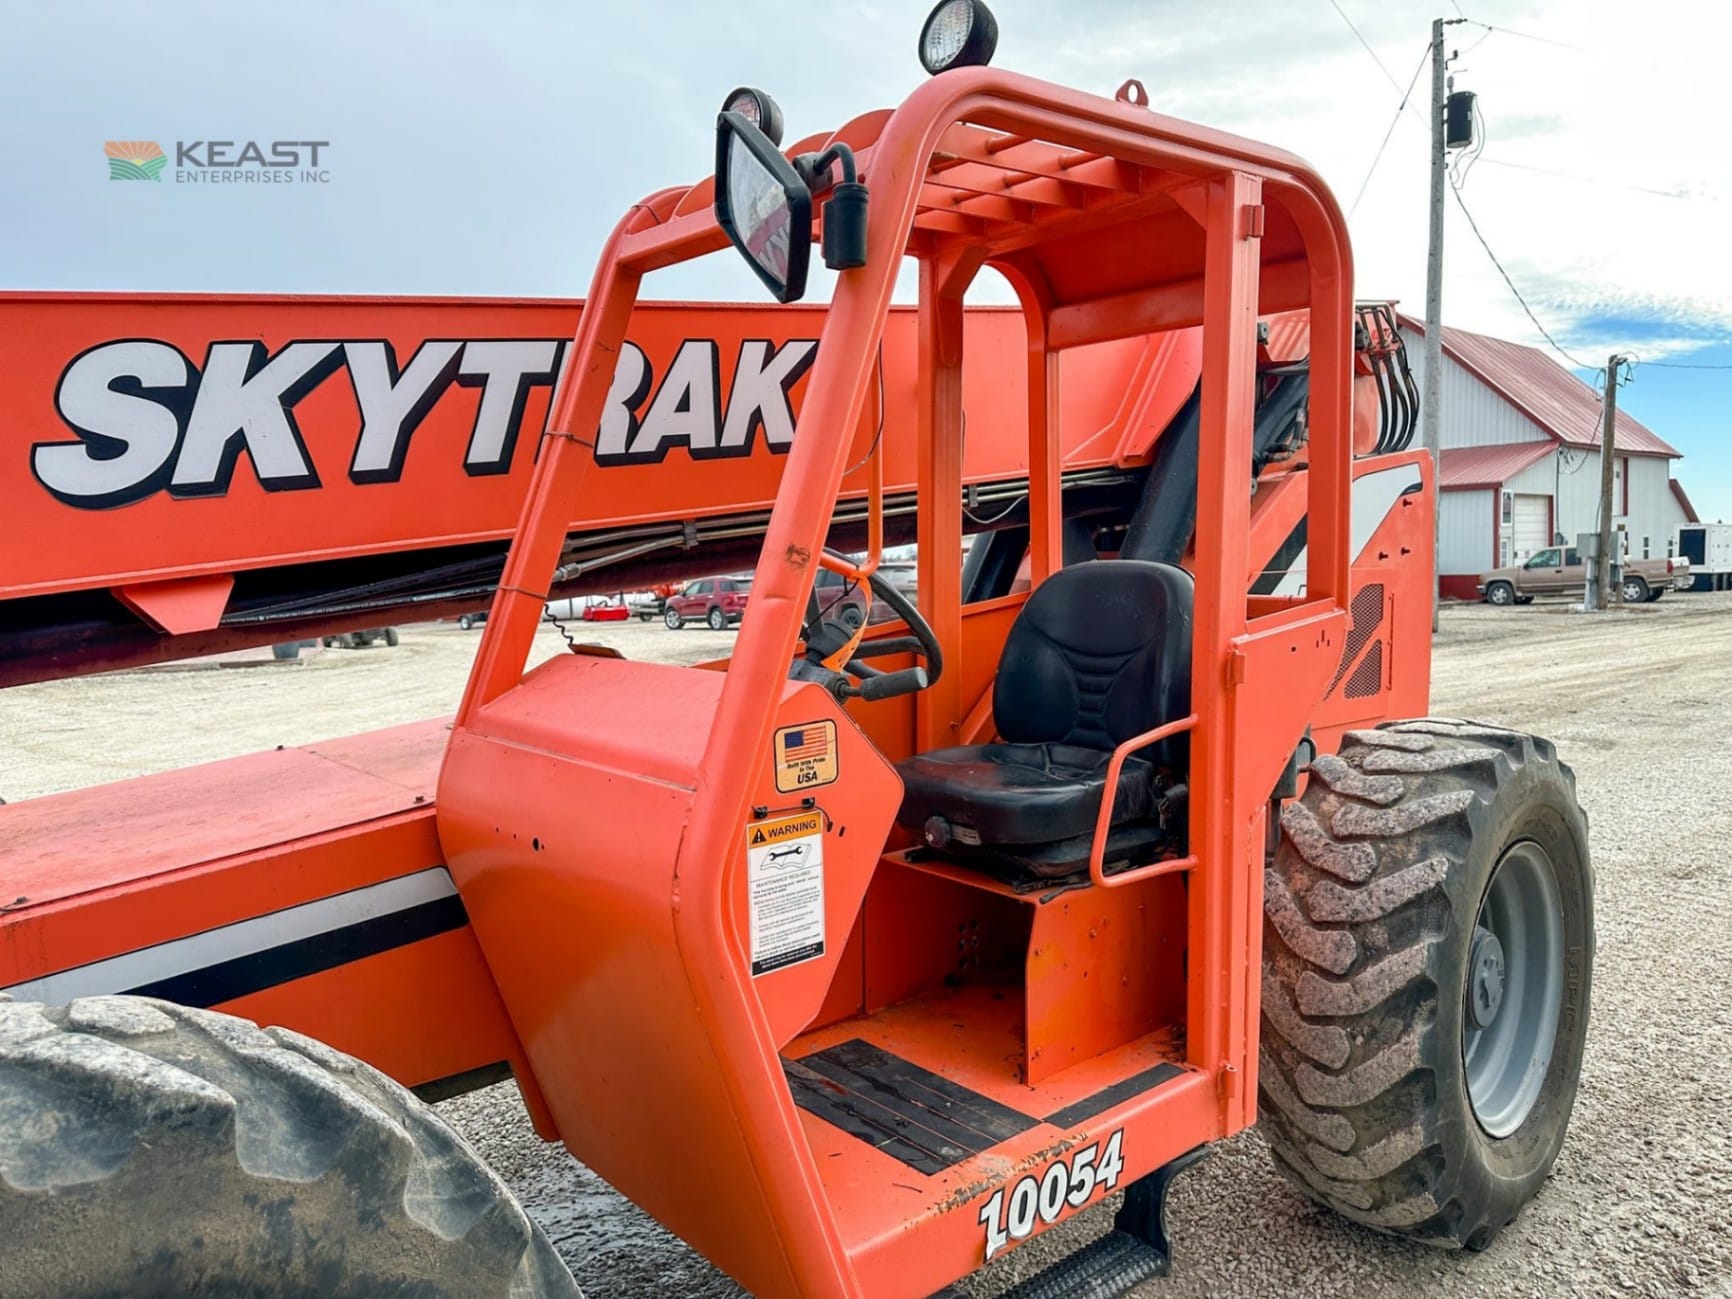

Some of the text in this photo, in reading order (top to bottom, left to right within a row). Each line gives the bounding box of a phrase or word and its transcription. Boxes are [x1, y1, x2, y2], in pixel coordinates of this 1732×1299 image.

[797, 770, 818, 785] USA
[768, 819, 817, 838] WARNING
[978, 1127, 1125, 1263] 10054
